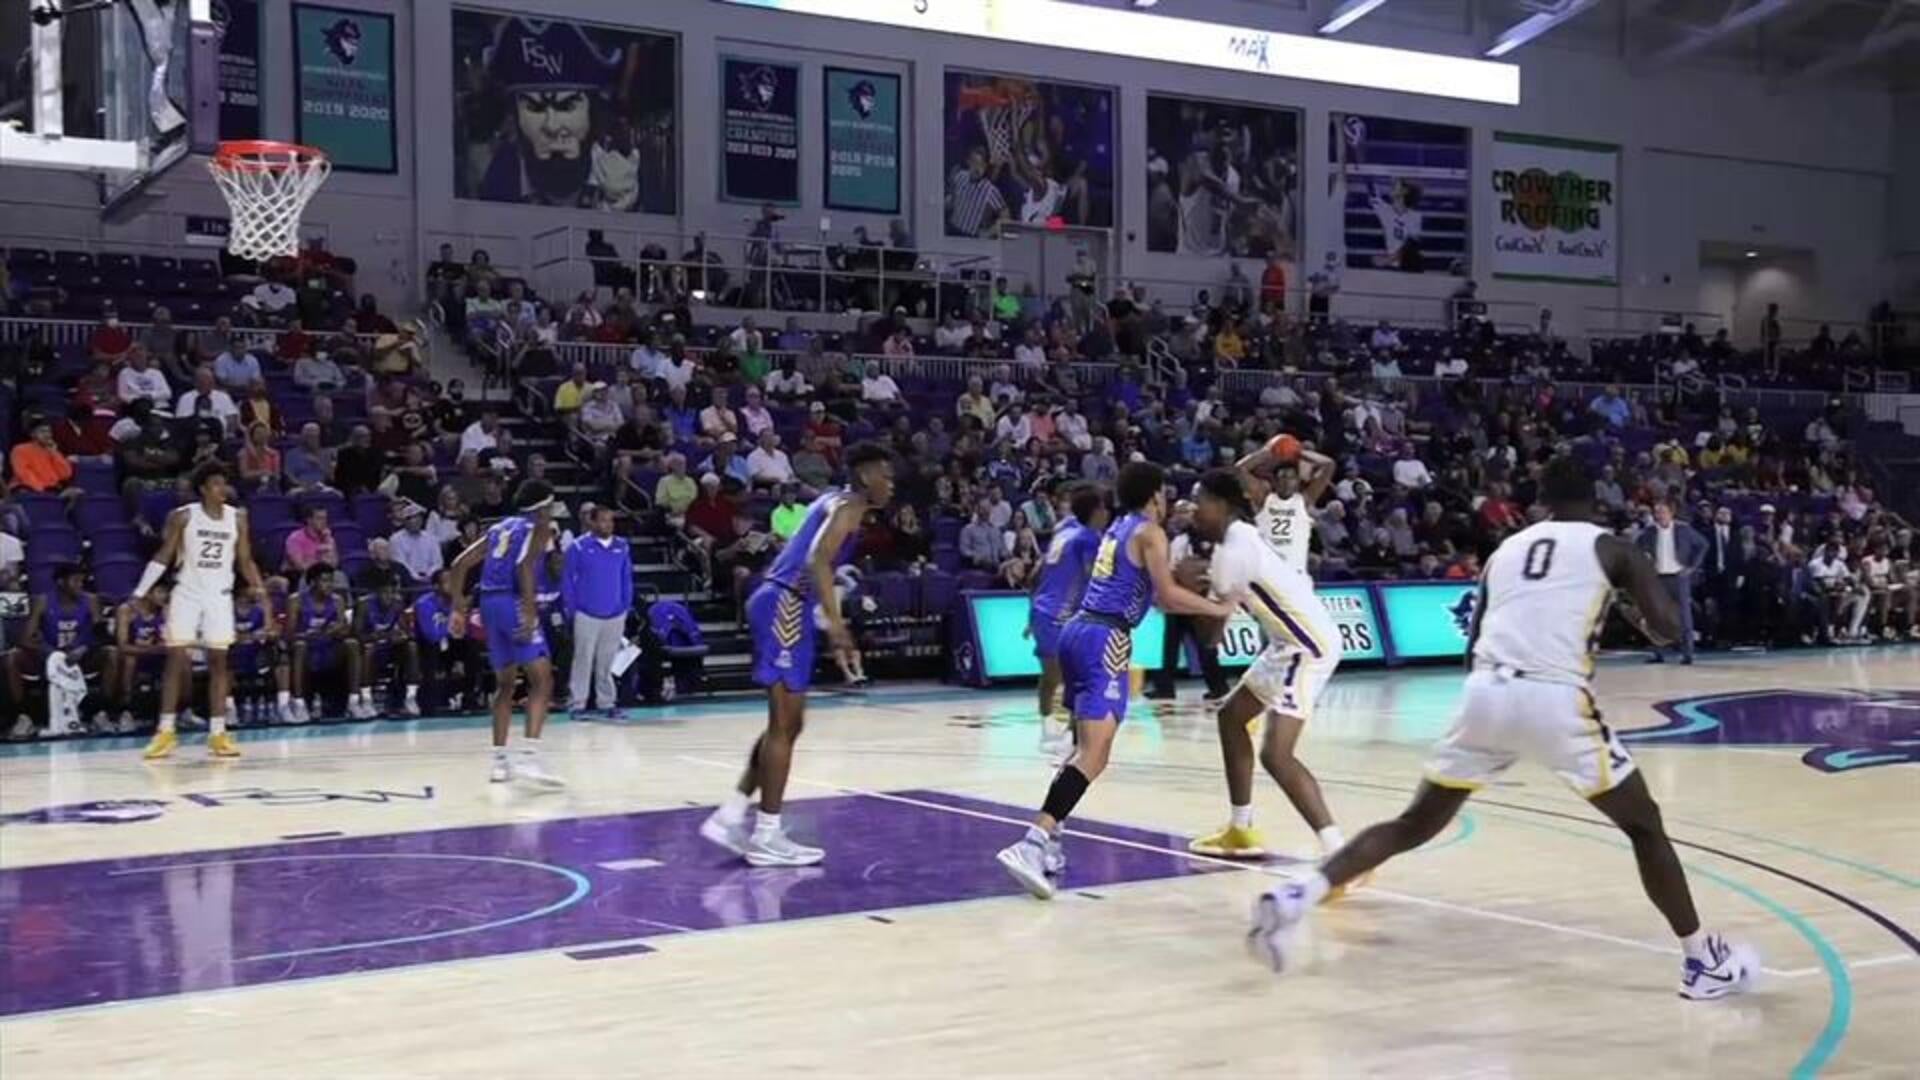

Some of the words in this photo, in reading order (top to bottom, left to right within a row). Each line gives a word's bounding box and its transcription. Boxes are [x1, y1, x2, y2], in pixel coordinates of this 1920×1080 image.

[521, 38, 564, 75] FSW
[1492, 171, 1612, 205] CROWTHER
[1501, 200, 1600, 230] ROOFING
[1271, 518, 1292, 536] 22
[200, 541, 223, 559] 23
[1522, 538, 1556, 580] 0
